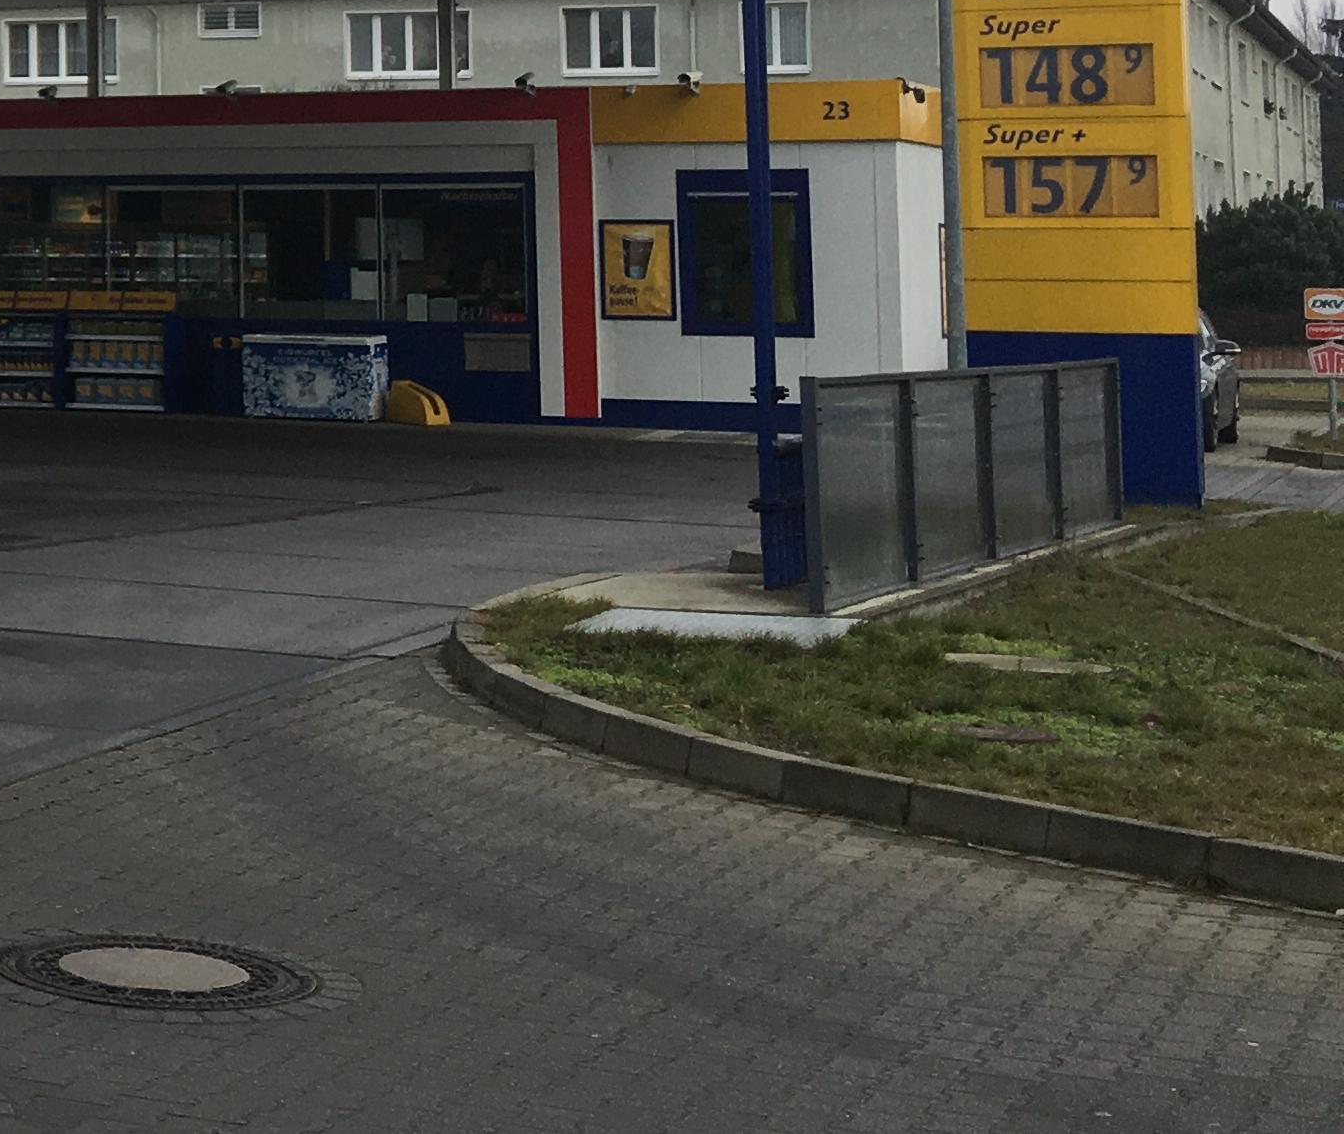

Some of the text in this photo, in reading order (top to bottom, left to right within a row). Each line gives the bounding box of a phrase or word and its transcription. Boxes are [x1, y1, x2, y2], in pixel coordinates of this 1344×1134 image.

[979, 15, 1060, 41] Super
[986, 46, 1108, 104] 148
[822, 101, 850, 121] 23
[983, 124, 1064, 150] Super
[989, 156, 1112, 214] 157
[1311, 298, 1344, 310] DKV
